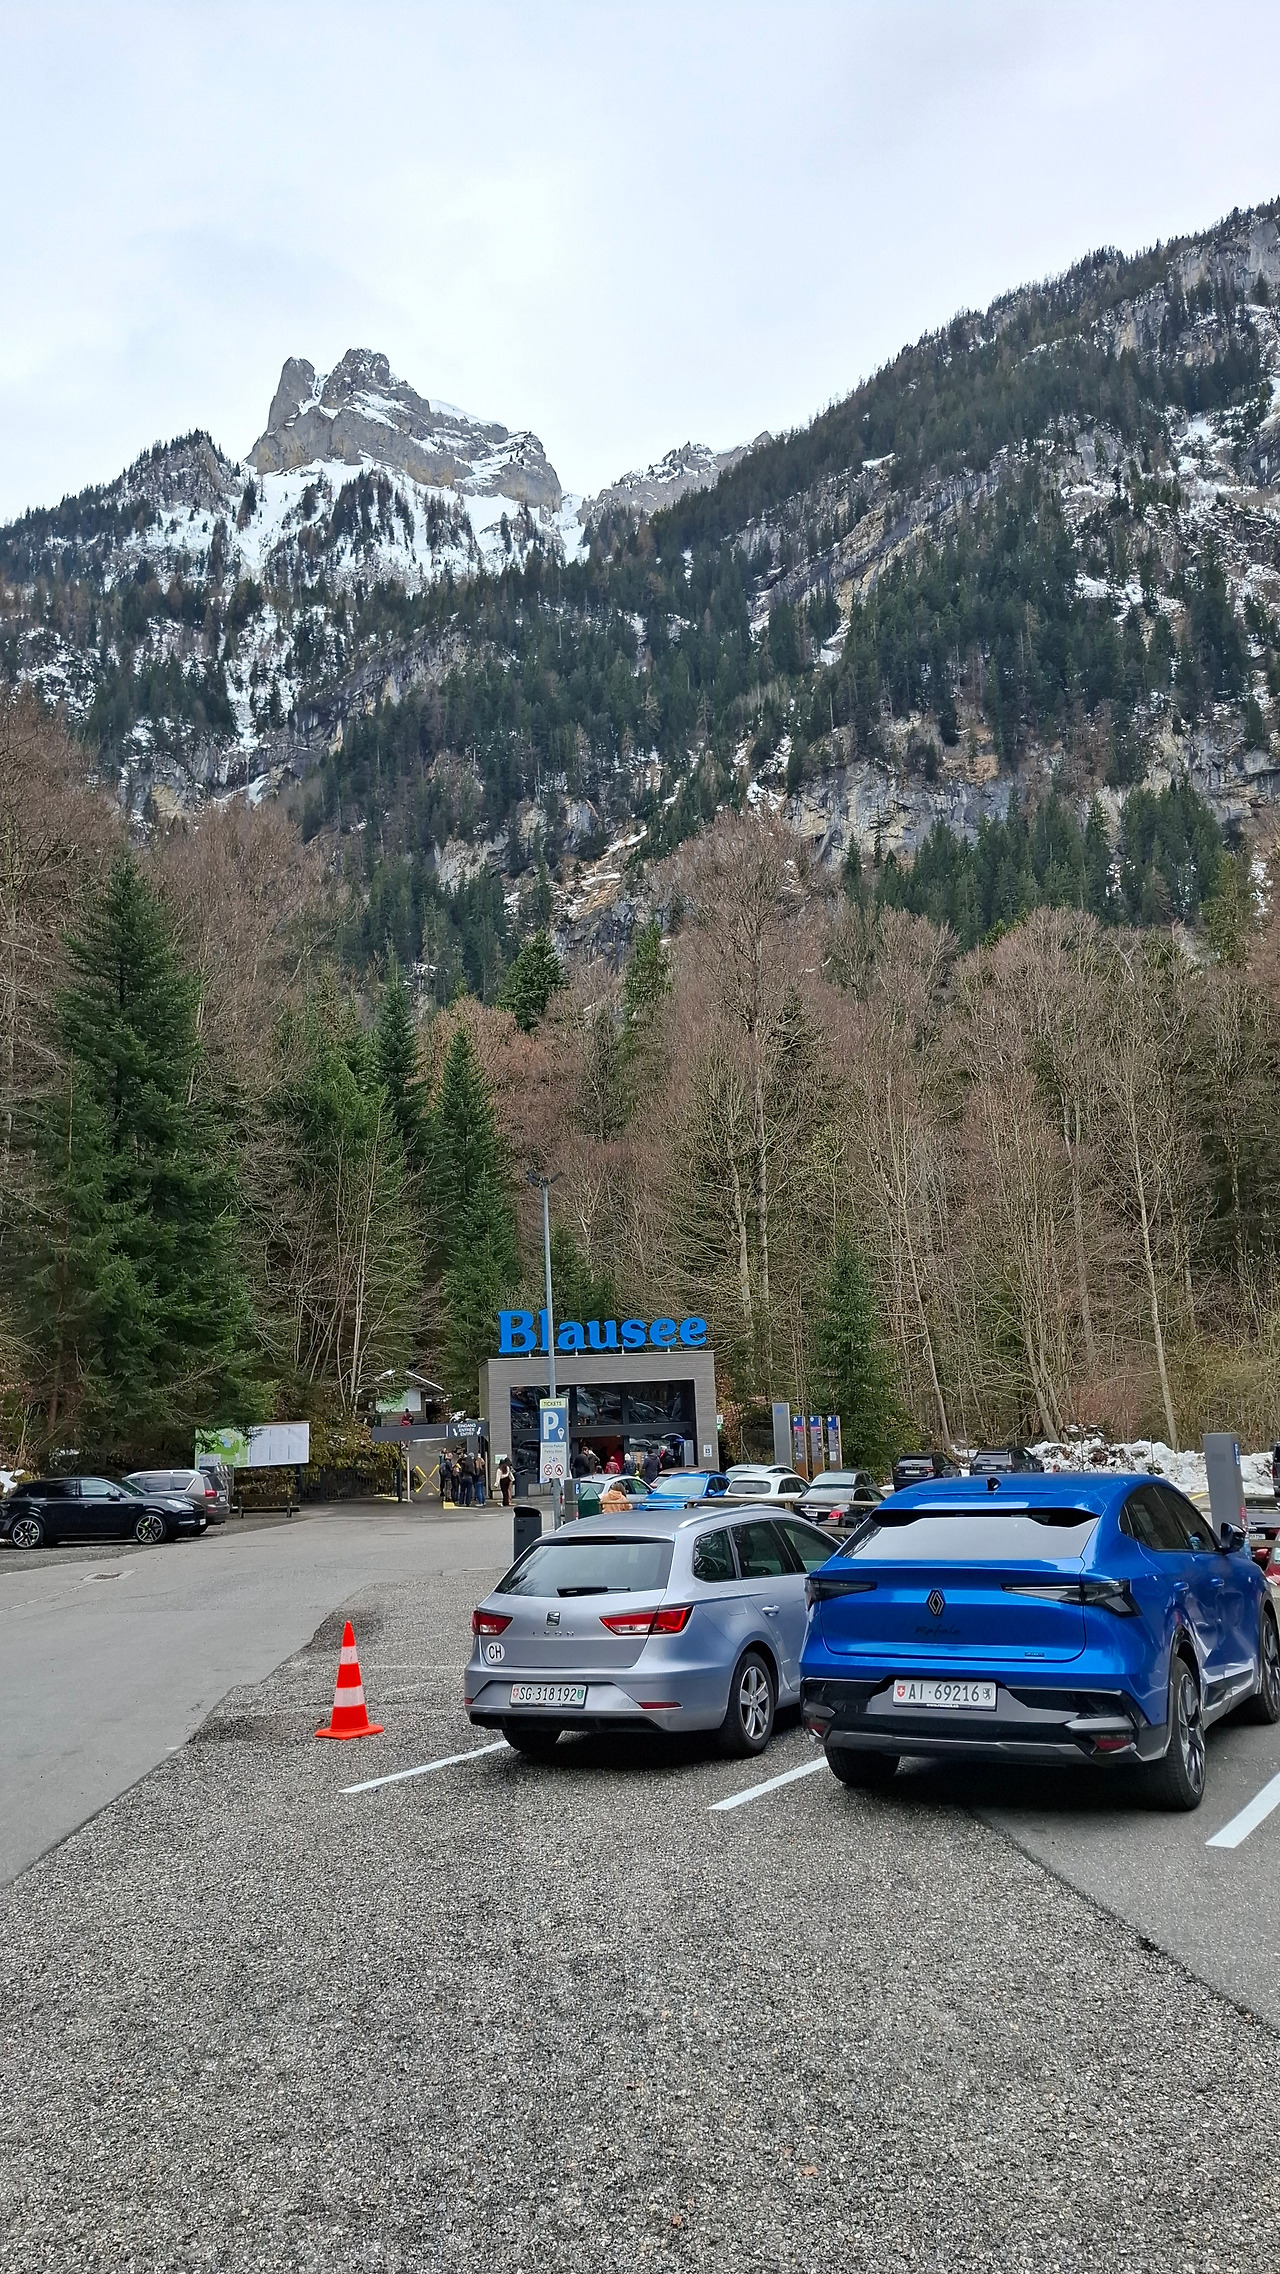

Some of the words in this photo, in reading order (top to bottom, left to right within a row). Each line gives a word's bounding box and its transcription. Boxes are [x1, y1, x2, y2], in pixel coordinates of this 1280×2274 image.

[498, 1308, 707, 1353] Blausee
[543, 1411, 559, 1440] P
[914, 1624, 961, 1638] Rafale
[488, 1645, 502, 1660] CH
